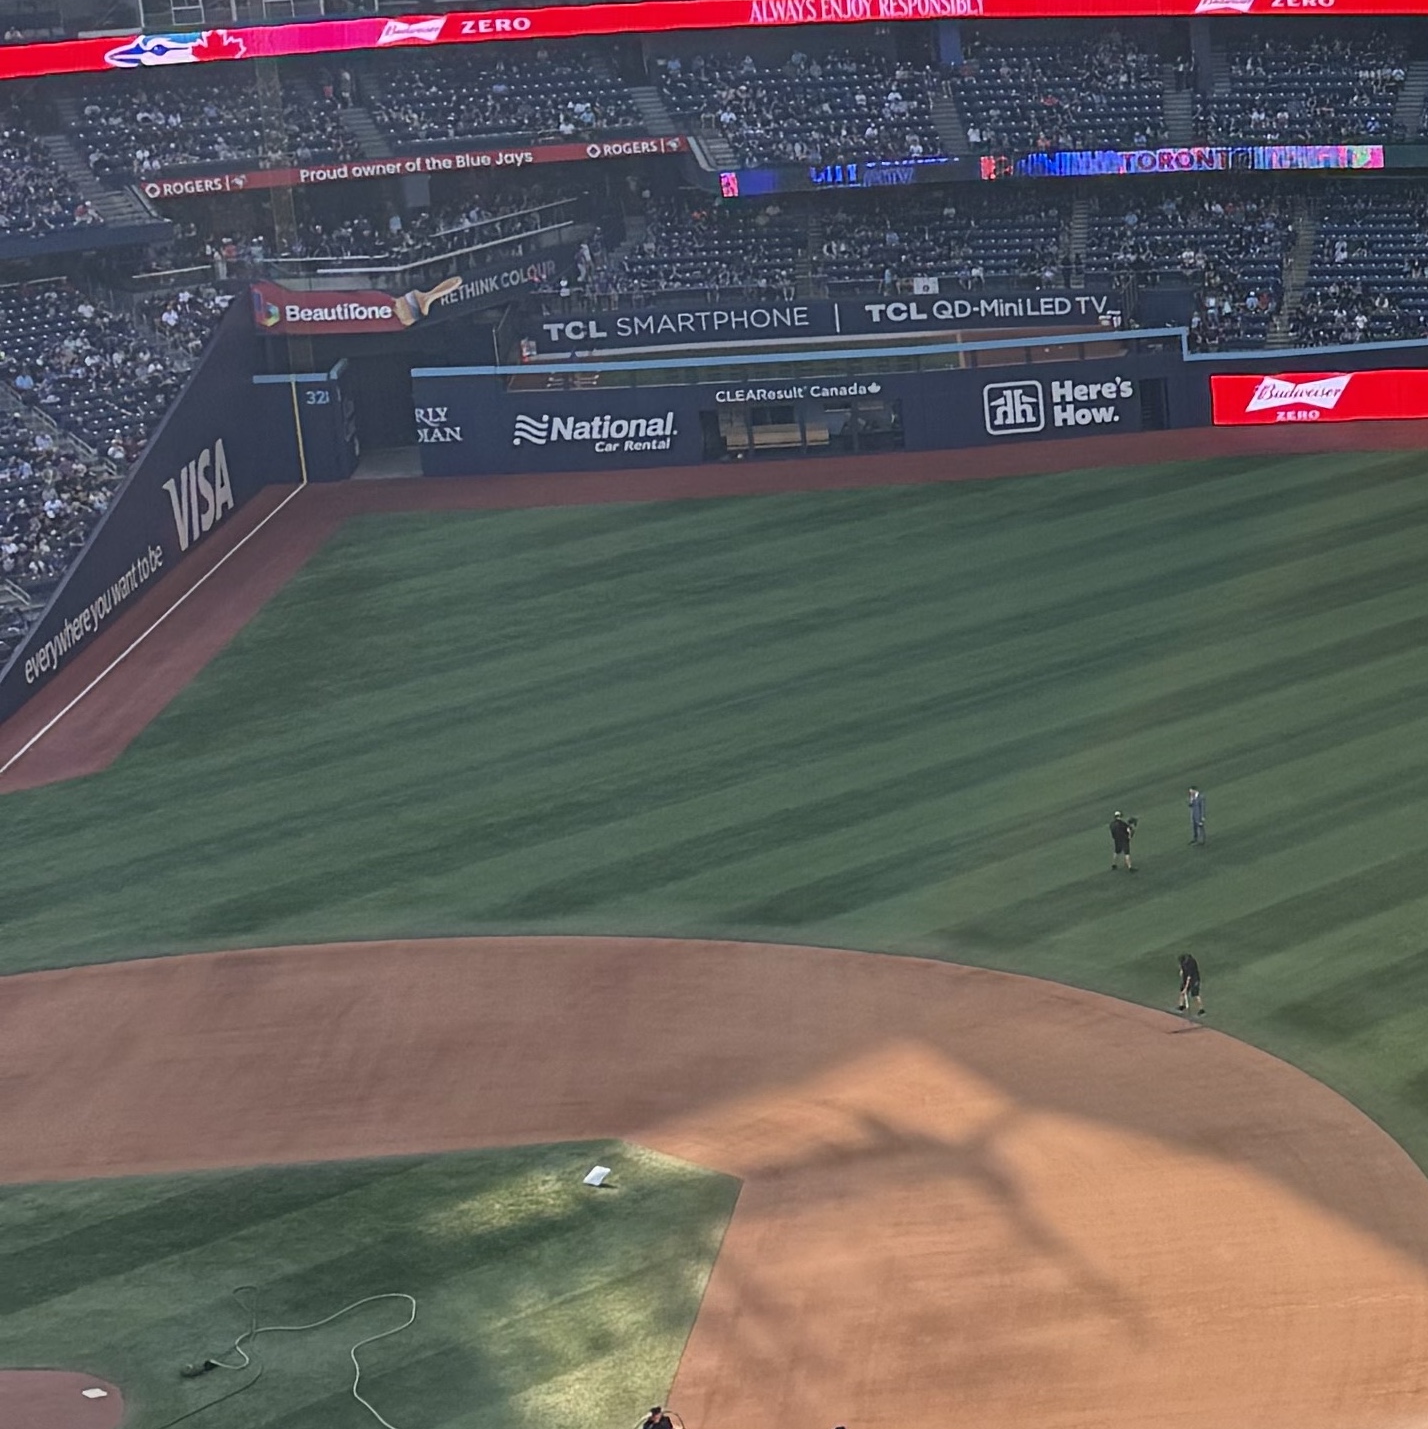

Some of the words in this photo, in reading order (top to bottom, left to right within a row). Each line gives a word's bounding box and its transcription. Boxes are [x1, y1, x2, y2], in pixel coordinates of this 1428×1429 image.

[461, 16, 531, 34] ZERO
[163, 178, 222, 197] ROGERS
[300, 163, 349, 183] Proud
[351, 162, 401, 178] owner
[405, 156, 423, 173] of
[424, 156, 452, 171] the
[455, 152, 491, 170] Blue
[494, 150, 534, 168] Jays
[603, 141, 658, 157] ROGERS
[286, 303, 392, 322] BeautiTone
[440, 276, 498, 306] RETHINK
[501, 260, 556, 287] COLOUR
[543, 320, 607, 342] TCL
[616, 306, 809, 338] SMARTPHONE
[865, 302, 927, 323] TCL
[1076, 296, 1107, 315] TV
[306, 391, 330, 406] 321
[715, 387, 802, 403] CLEAResult
[810, 384, 866, 399] Canada
[1051, 376, 1133, 403] Here's
[1053, 403, 1120, 427] How.
[1276, 409, 1320, 422] ZERO
[594, 440, 620, 453] Car
[625, 438, 671, 452] Rental
[162, 438, 235, 552] VISA
[25, 614, 92, 684] everywhere
[90, 589, 111, 632] you
[111, 567, 139, 606] want
[137, 561, 150, 581] to
[148, 545, 164, 573] be
